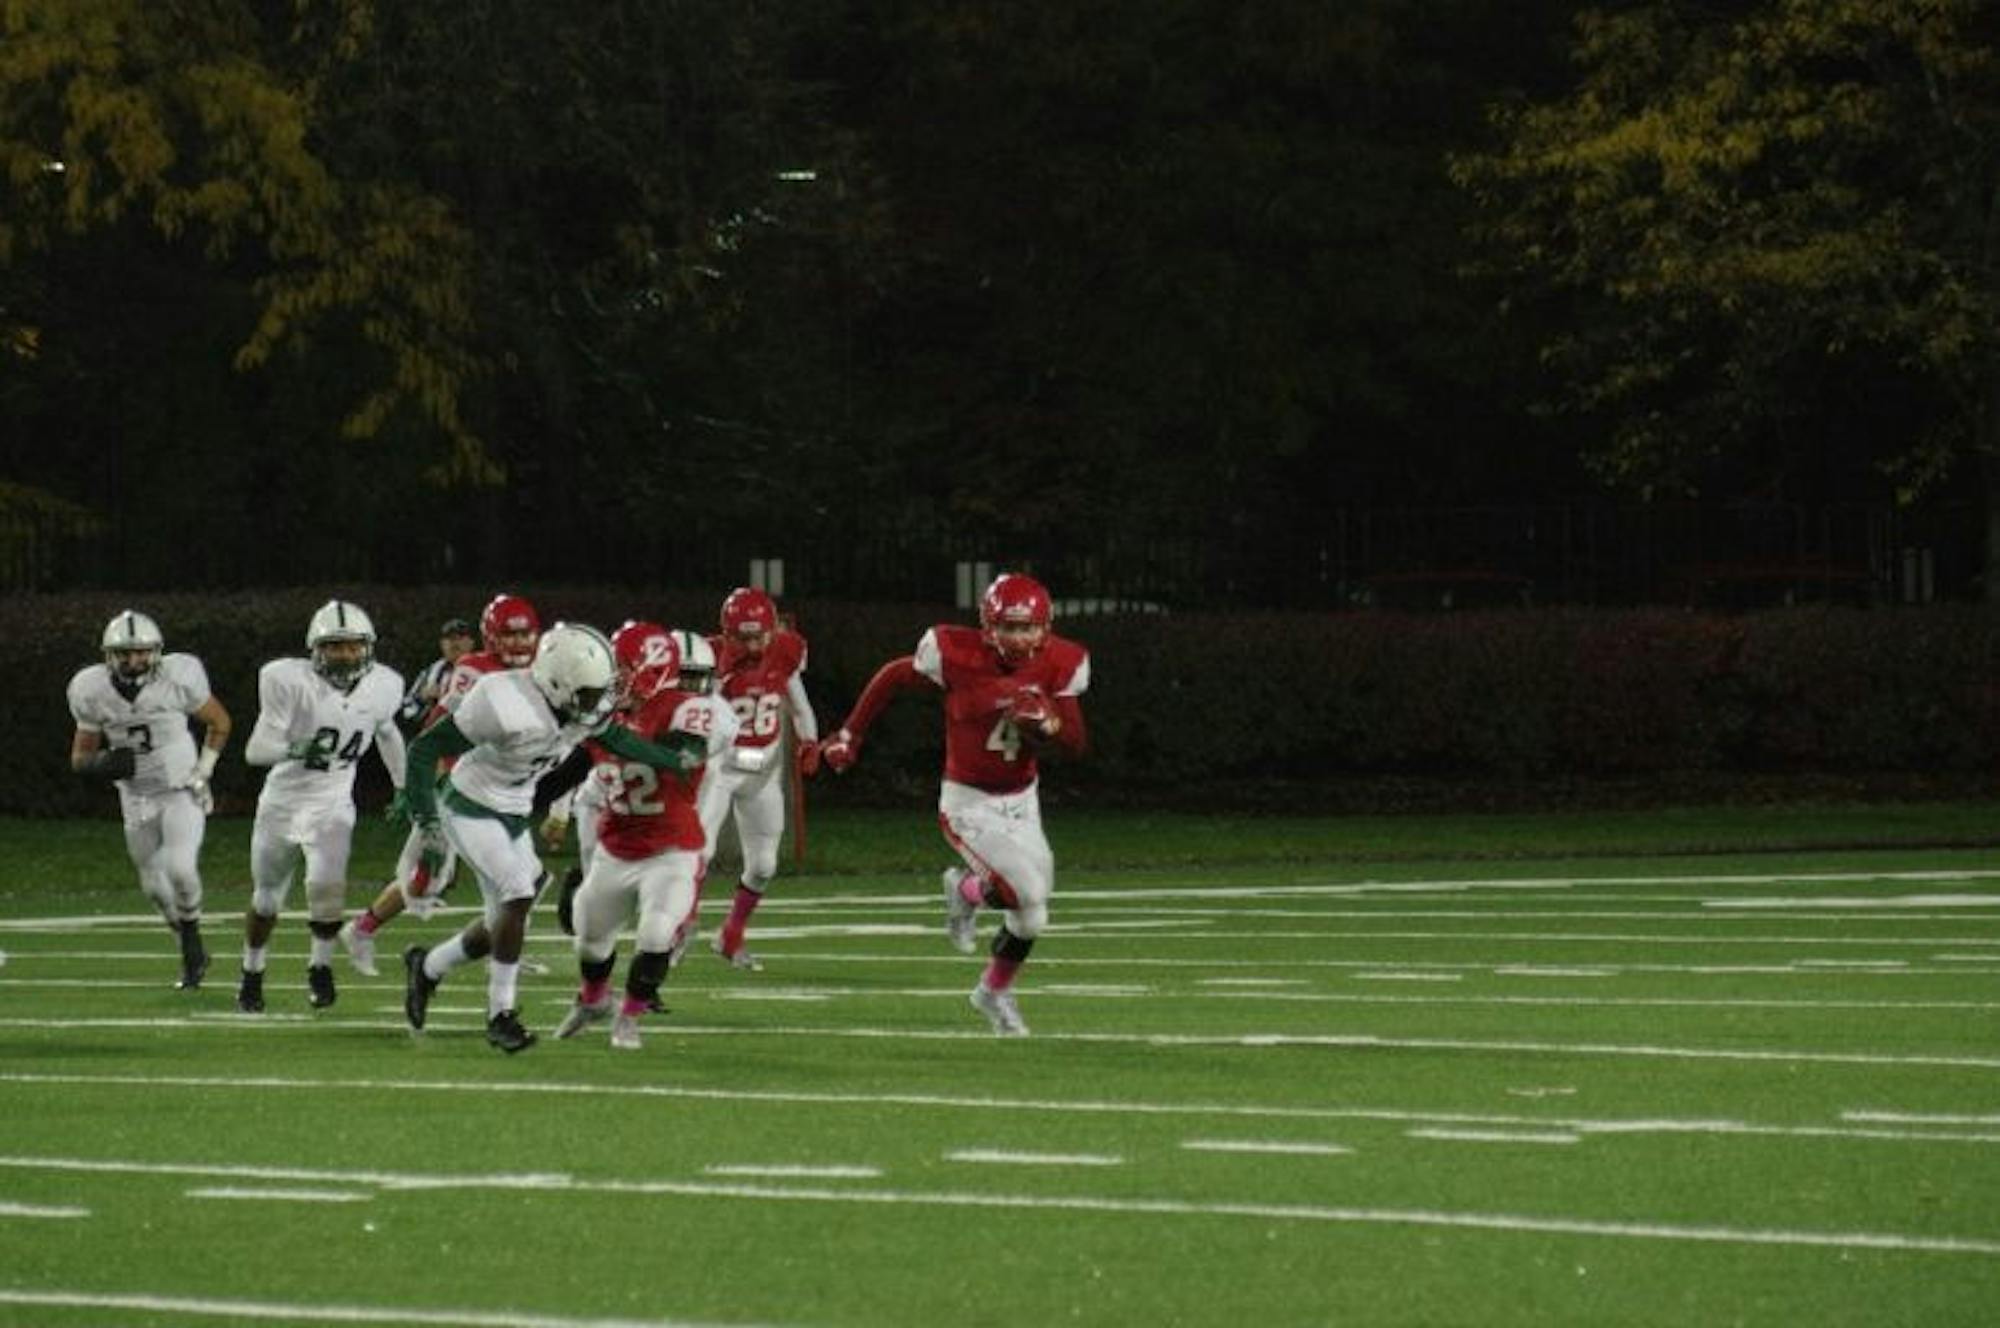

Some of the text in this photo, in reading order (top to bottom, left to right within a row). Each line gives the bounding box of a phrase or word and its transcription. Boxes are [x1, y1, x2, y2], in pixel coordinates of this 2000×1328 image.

[685, 707, 713, 732] 22
[730, 693, 781, 737] 26
[126, 723, 153, 755] 3
[985, 714, 1022, 762] 4
